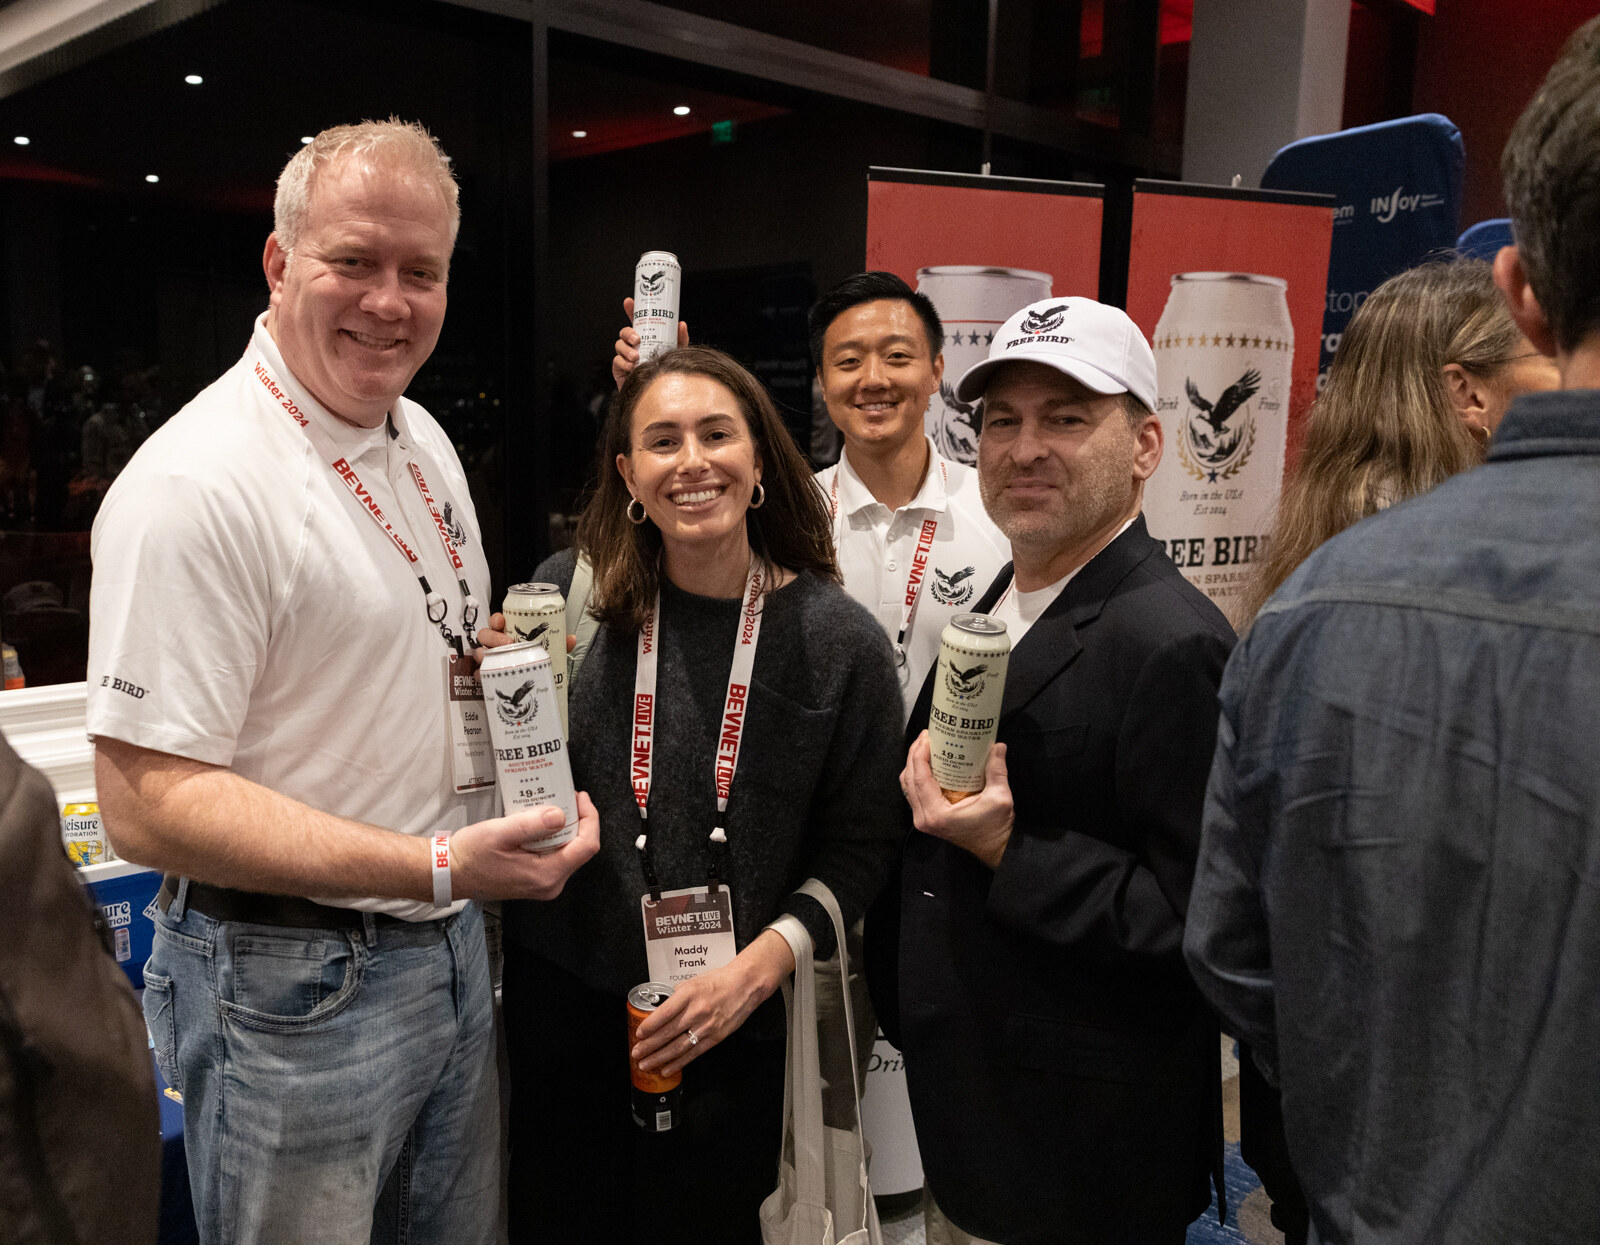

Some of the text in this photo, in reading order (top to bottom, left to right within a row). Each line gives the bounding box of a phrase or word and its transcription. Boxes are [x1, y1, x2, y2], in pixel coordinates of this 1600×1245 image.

[1006, 336, 1035, 350] FREE
[254, 361, 309, 428] Winter 2024
[920, 521, 937, 544] LIVE
[741, 617, 755, 645] 2024
[637, 694, 652, 725] LIVE
[465, 711, 478, 721] Eddie
[960, 718, 994, 729] BIRD
[463, 726, 482, 736] Pearson
[526, 739, 561, 758] BIRD
[942, 750, 965, 760] 19.2
[508, 757, 546, 768] SOUTHERN
[529, 761, 553, 771] WATER
[718, 768, 732, 799] LIVE
[519, 787, 545, 798] 19.2
[656, 911, 720, 927] BEVNET LIVE
[657, 921, 721, 935] Winter 2024
[674, 945, 708, 956] Maddy
[679, 958, 706, 968] Frank
